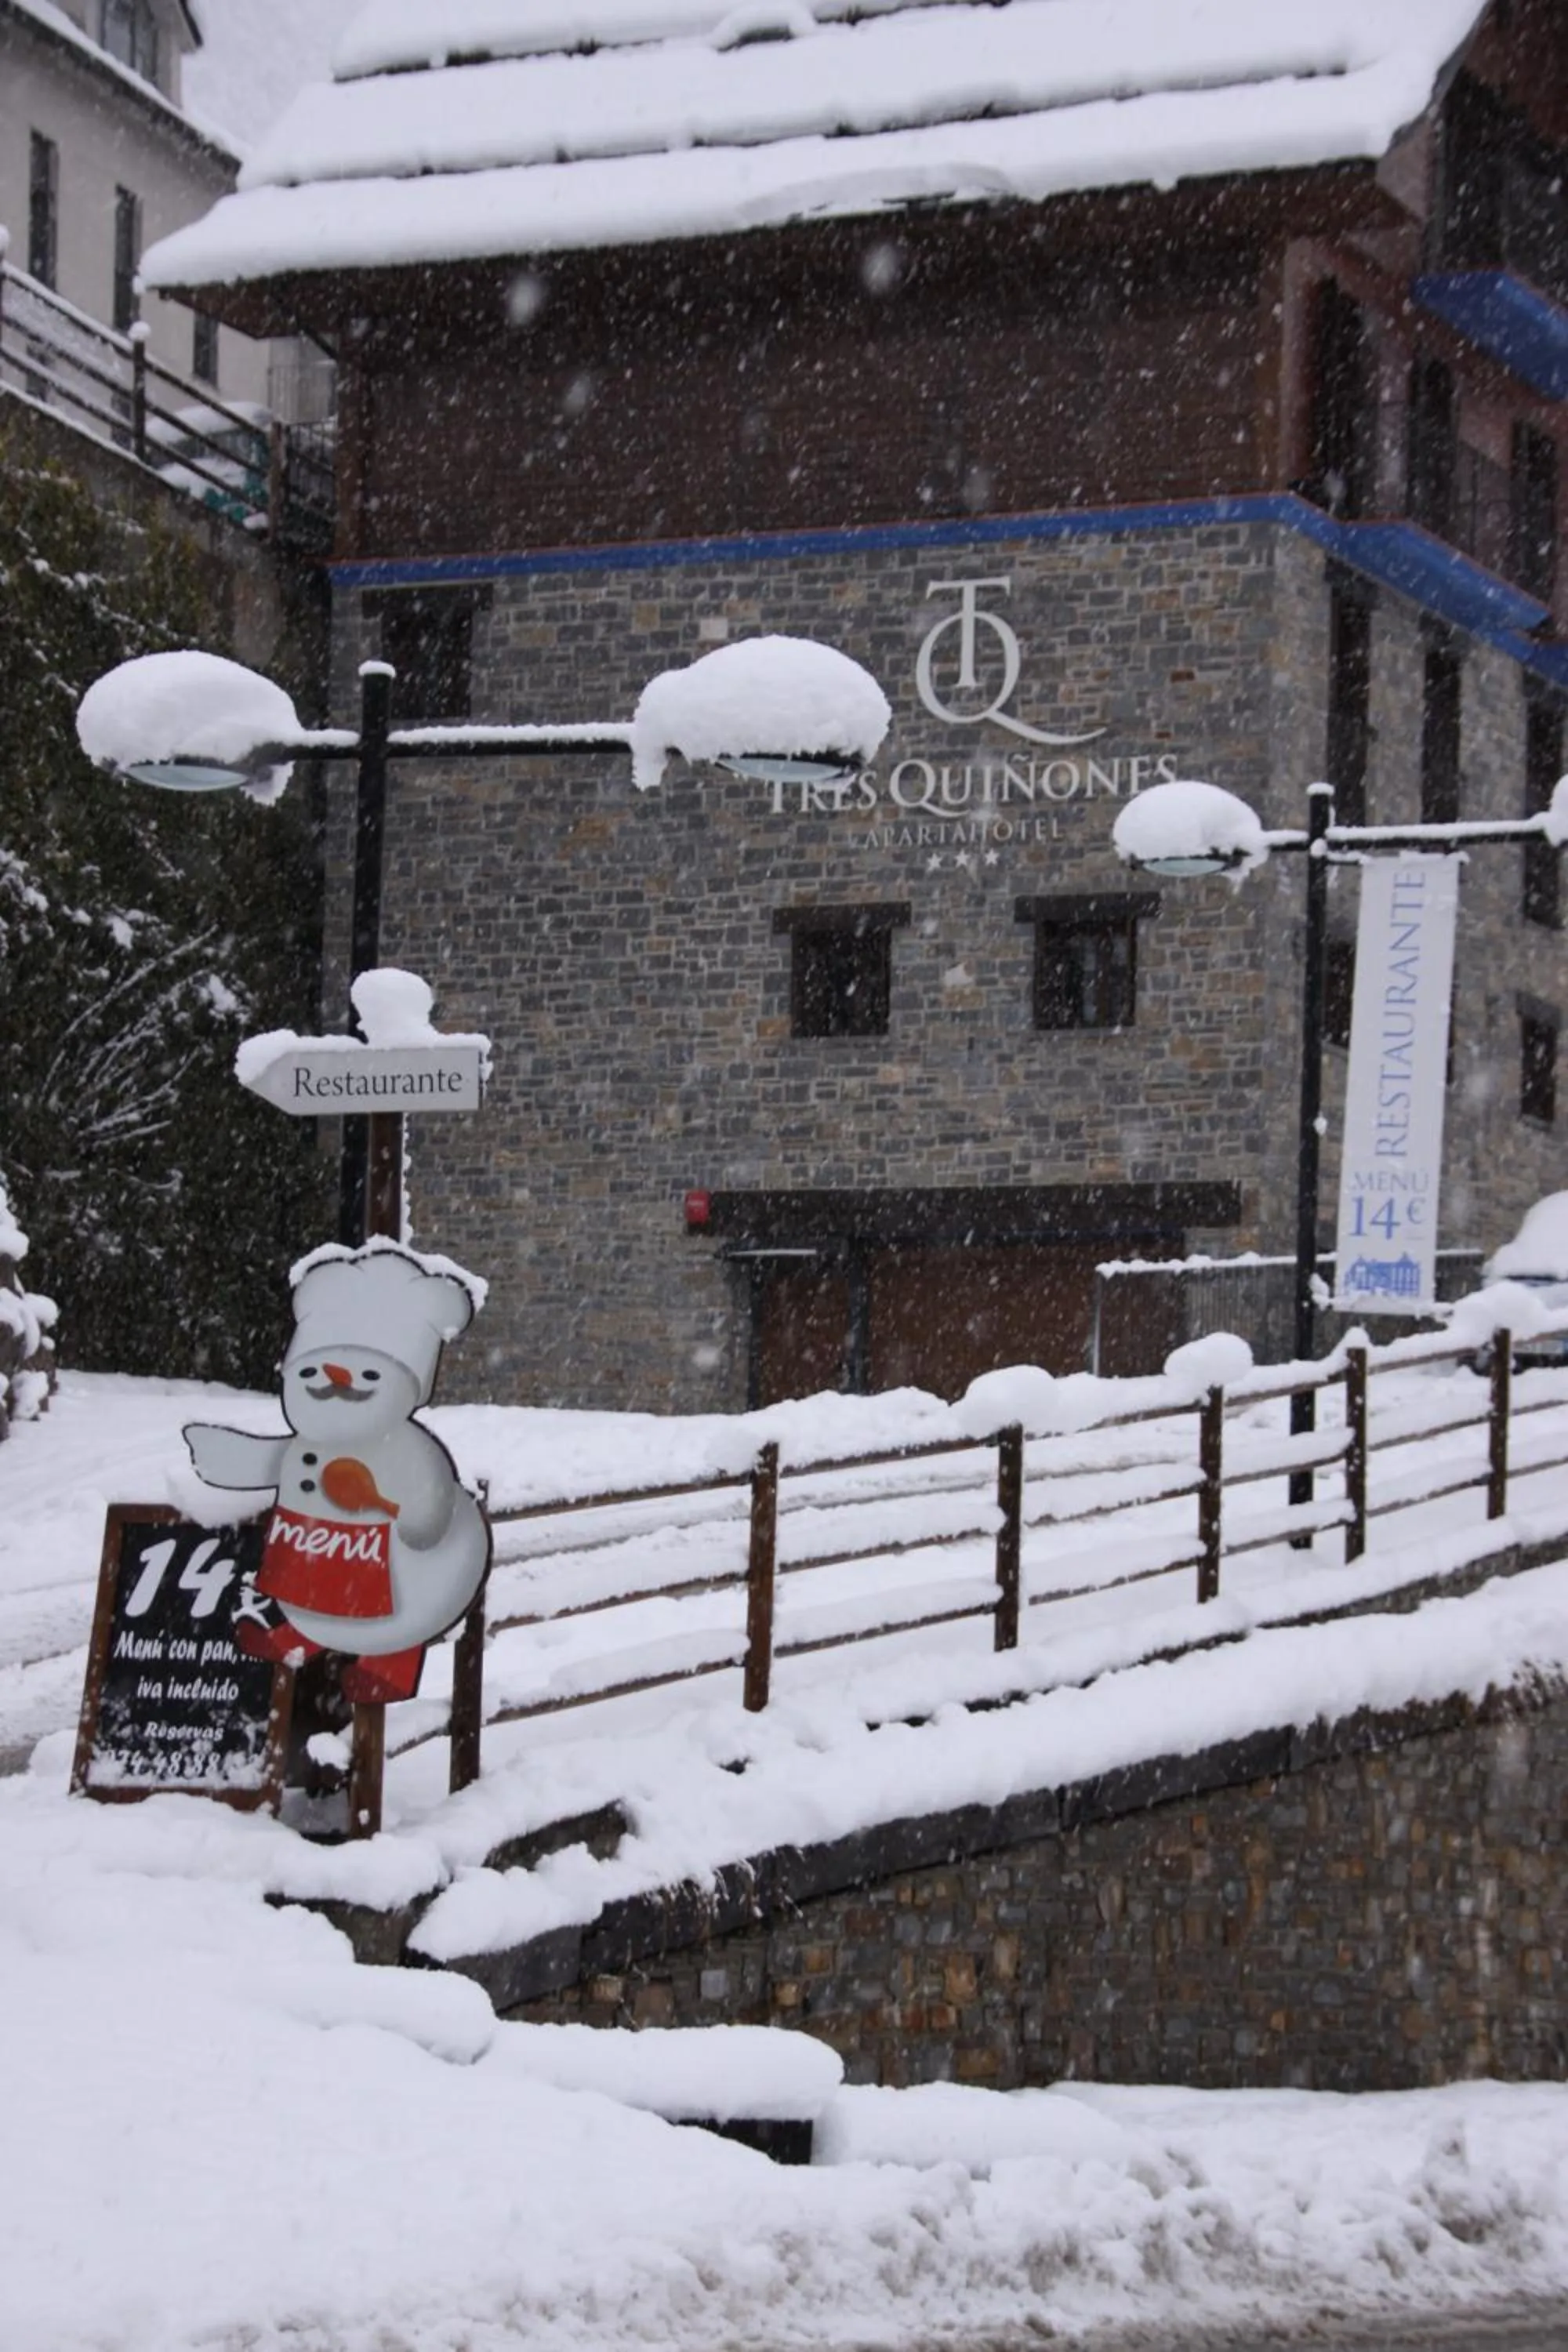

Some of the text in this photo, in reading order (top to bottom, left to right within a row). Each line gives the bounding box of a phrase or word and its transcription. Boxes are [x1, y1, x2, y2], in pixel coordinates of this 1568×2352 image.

[1374, 871, 1426, 1160] RESTAURANTE
[293, 1066, 463, 1098] Restaurante
[268, 1514, 383, 1563] menú
[114, 1628, 163, 1661] Menú
[169, 1637, 197, 1660] con
[137, 1675, 239, 1700] iva incluido
[144, 1722, 225, 1741] Reservas
